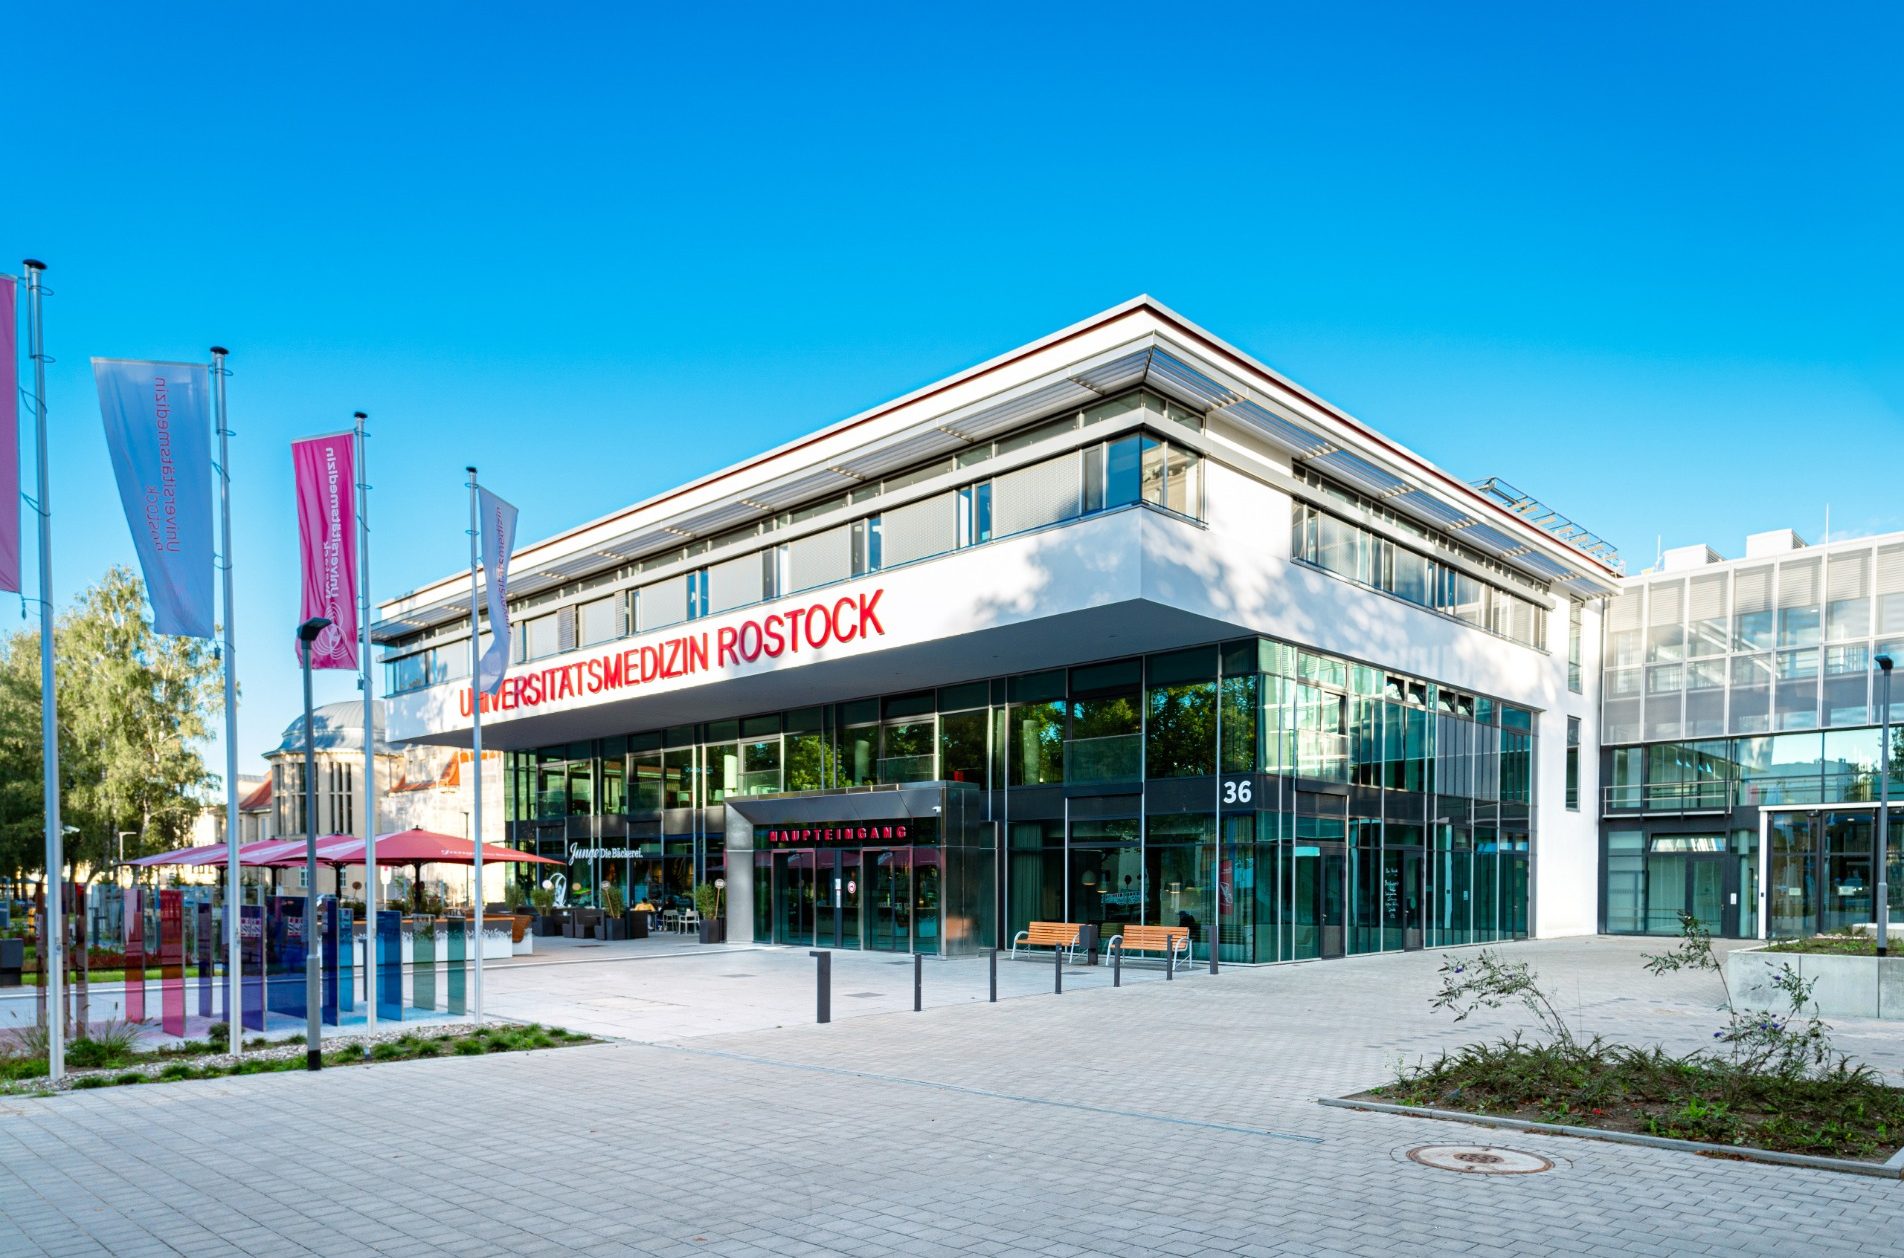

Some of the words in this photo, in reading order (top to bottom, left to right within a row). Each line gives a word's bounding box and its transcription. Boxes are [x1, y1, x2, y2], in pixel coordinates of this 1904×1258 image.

[717, 588, 885, 667] ROSTOCK
[1223, 780, 1252, 804] 36
[768, 825, 907, 842] HAUPTEINGANG
[568, 842, 600, 866] Junge
[600, 847, 612, 858] Die
